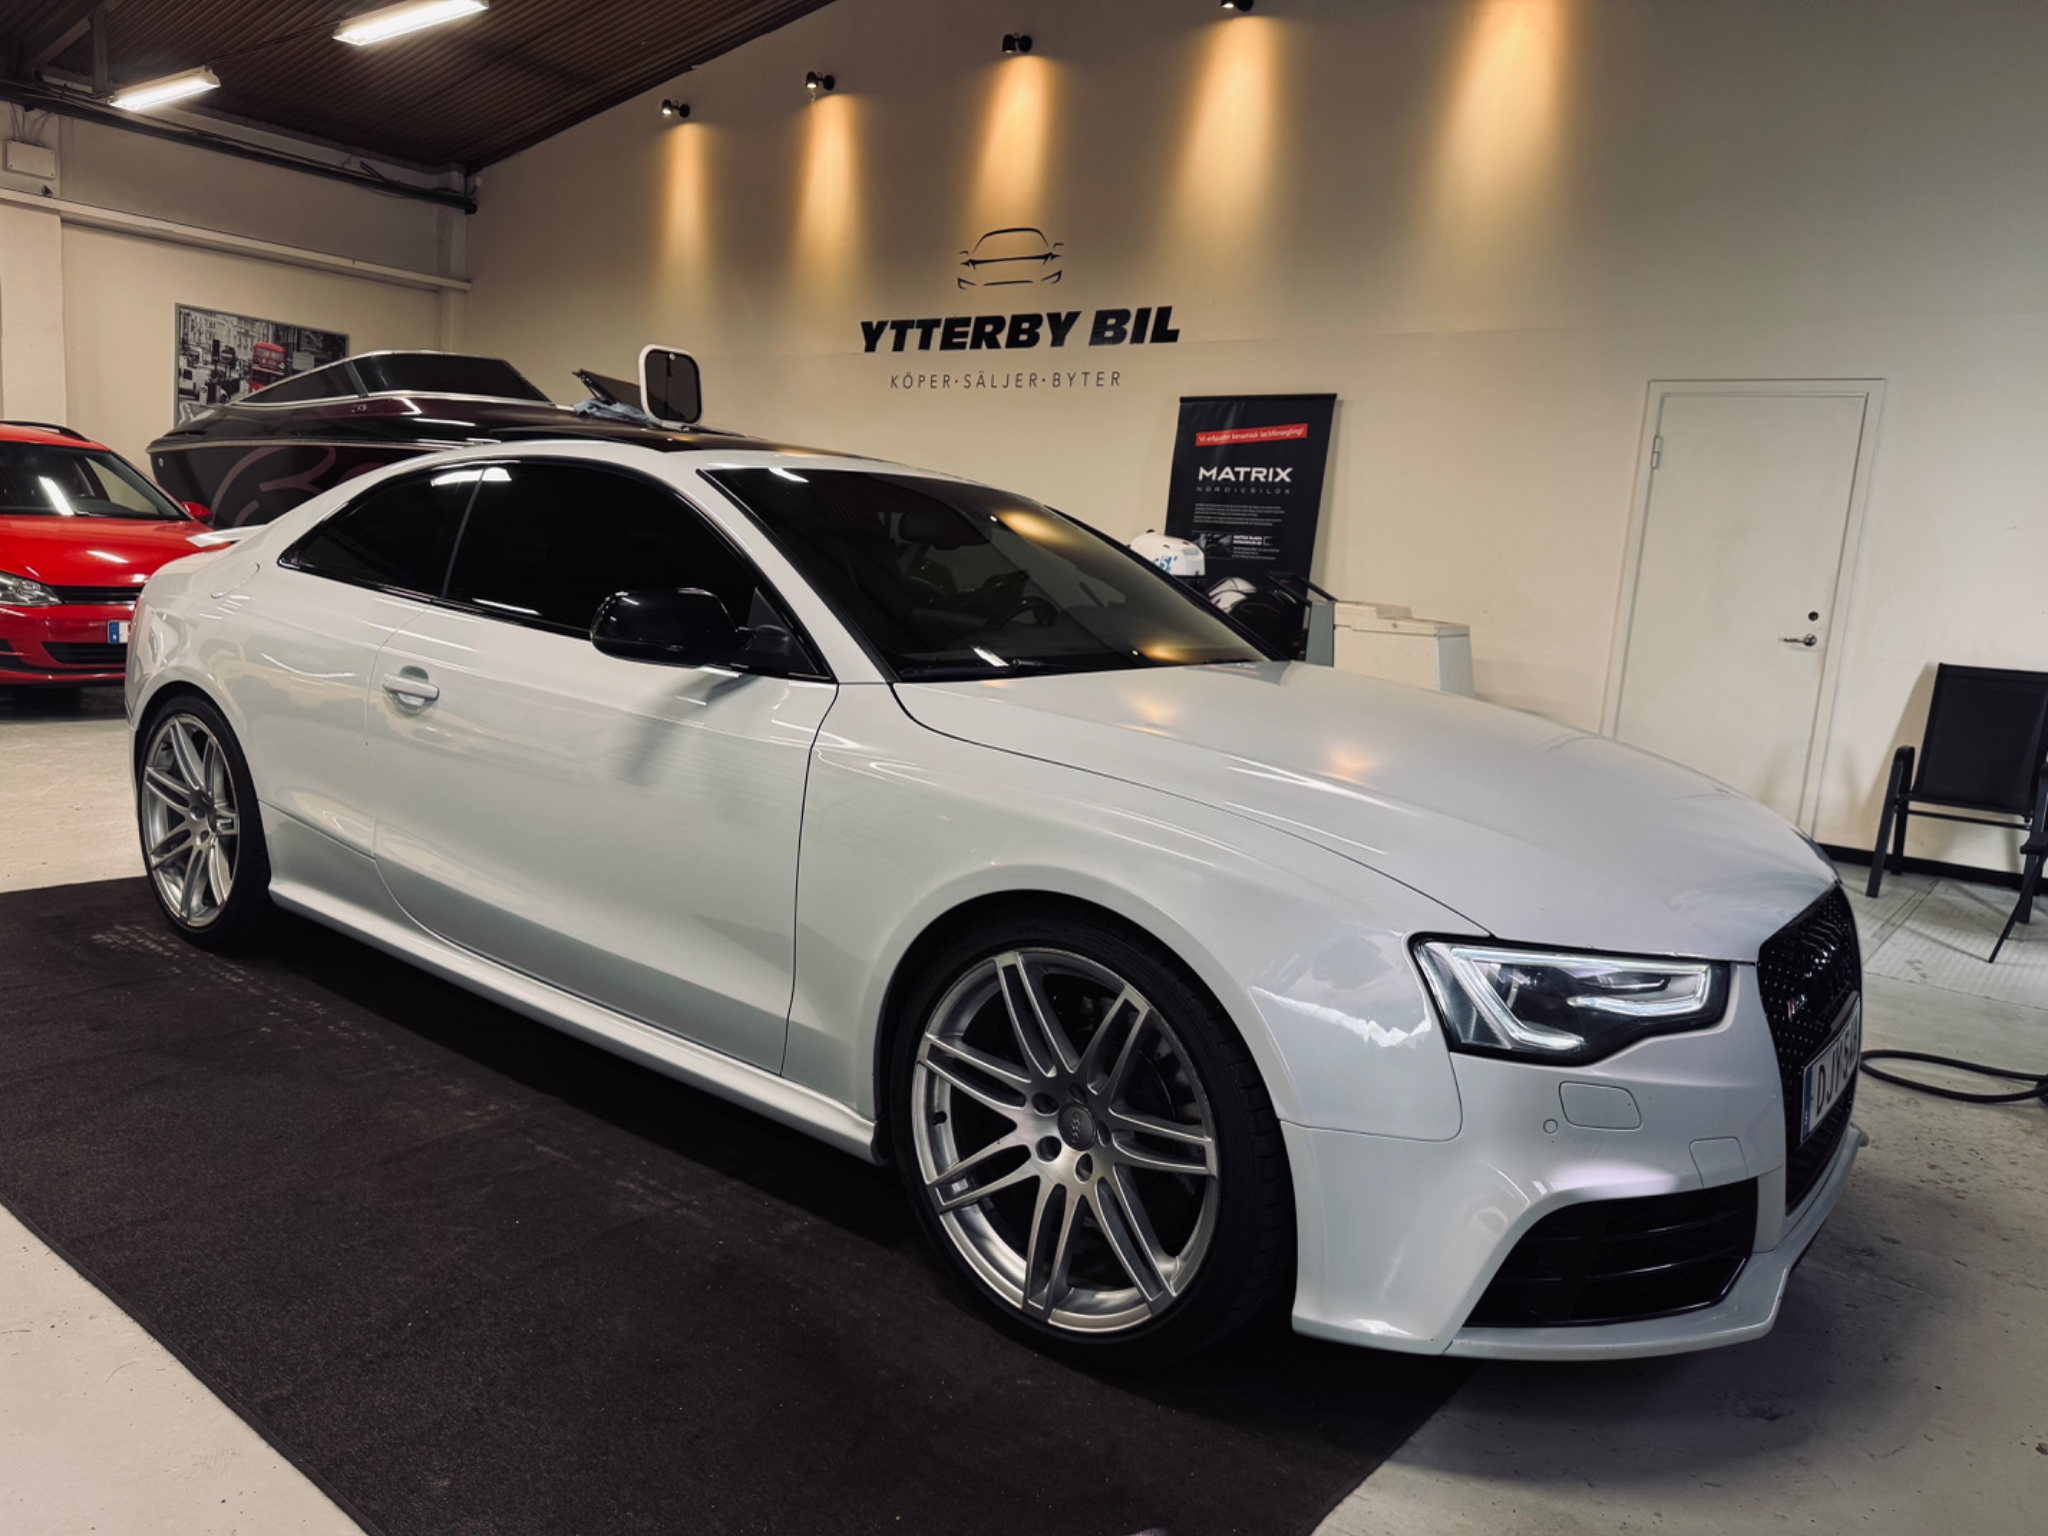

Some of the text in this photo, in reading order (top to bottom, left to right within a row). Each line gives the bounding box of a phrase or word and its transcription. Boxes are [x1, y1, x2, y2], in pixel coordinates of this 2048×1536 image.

[860, 306, 1180, 353] YTTERBY BIL
[1207, 433, 1231, 443] erbjuder
[1232, 431, 1258, 440] keramisk
[1260, 427, 1305, 438] lackförsegling!
[1198, 466, 1293, 482] MATRIX
